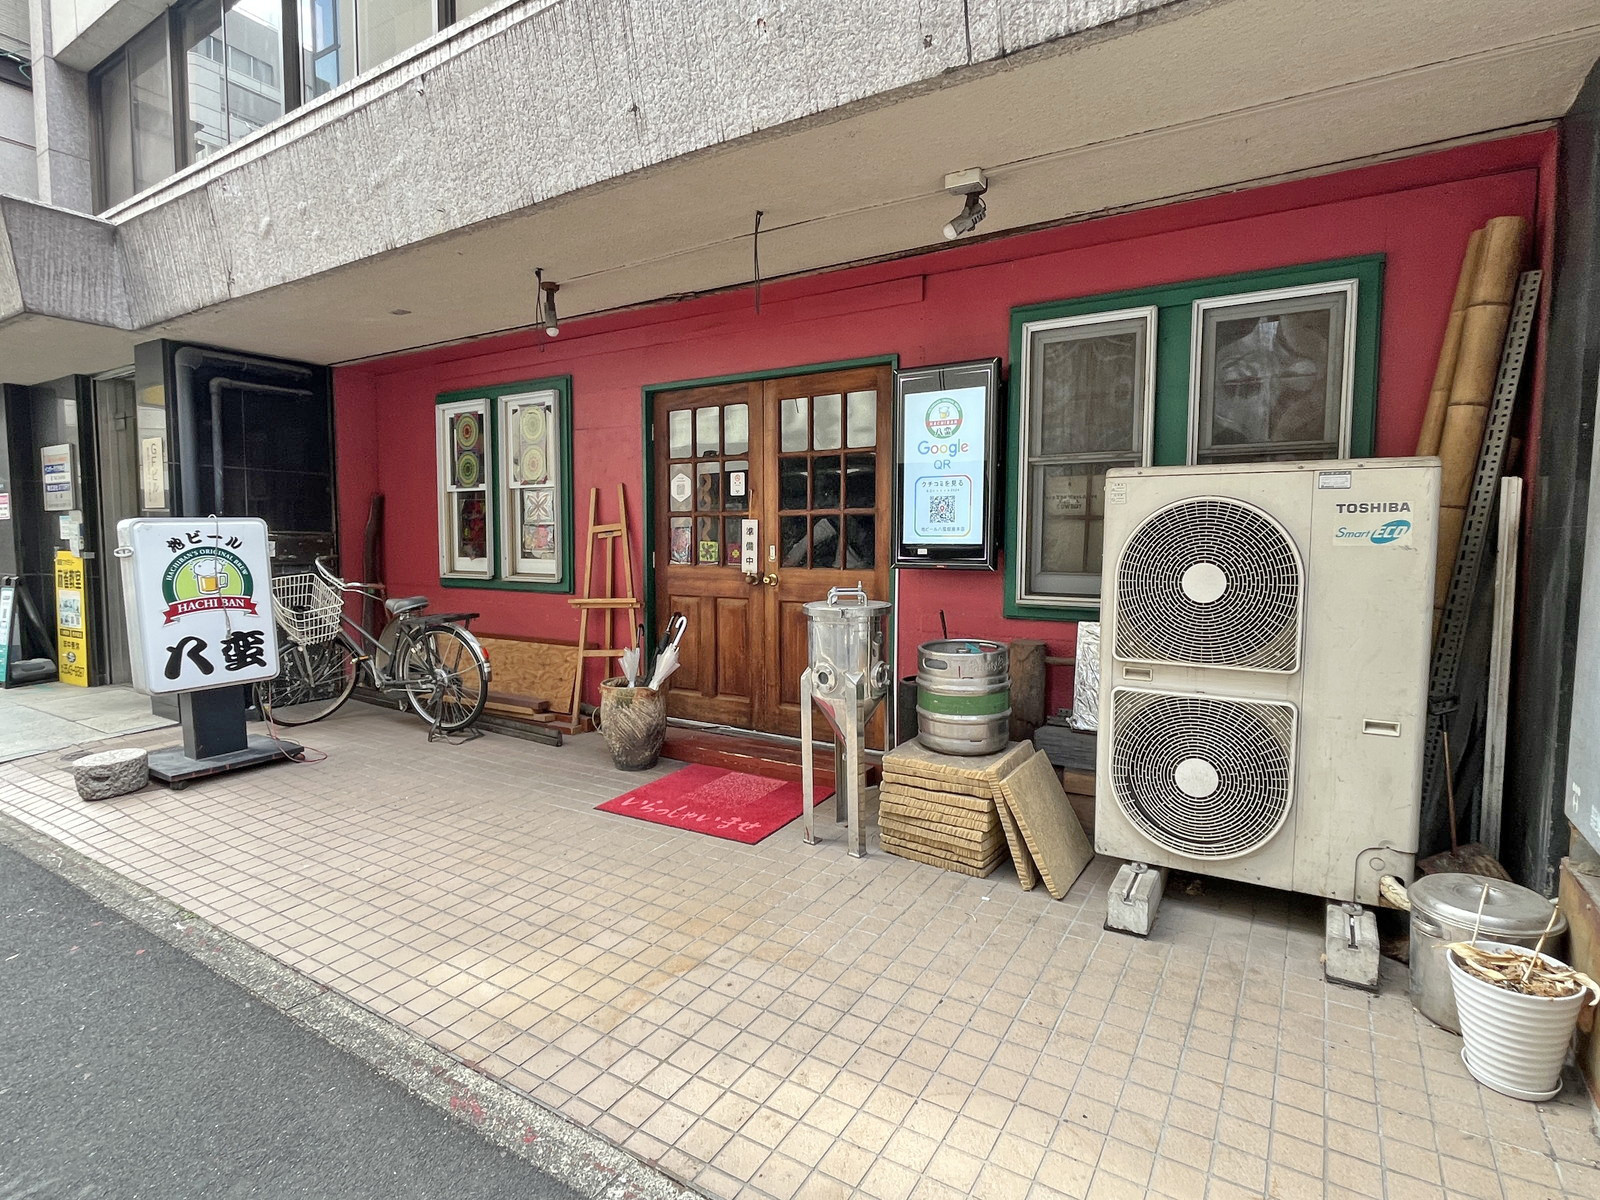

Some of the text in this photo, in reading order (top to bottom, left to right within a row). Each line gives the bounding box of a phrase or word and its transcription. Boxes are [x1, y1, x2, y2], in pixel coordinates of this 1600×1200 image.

[917, 438, 969, 457] Google
[934, 459, 951, 469] QR
[921, 479, 964, 487] クチコミを見る
[1336, 502, 1411, 513] TOSHIBA
[1335, 527, 1370, 538] Smart
[166, 530, 243, 553] 地ビール
[745, 526, 754, 565] 準備中
[165, 549, 249, 581] HACHIBAN'S ORIGINAL BREW
[177, 599, 245, 613] HACHI BAN
[621, 796, 762, 832] いらっしゃいませ
